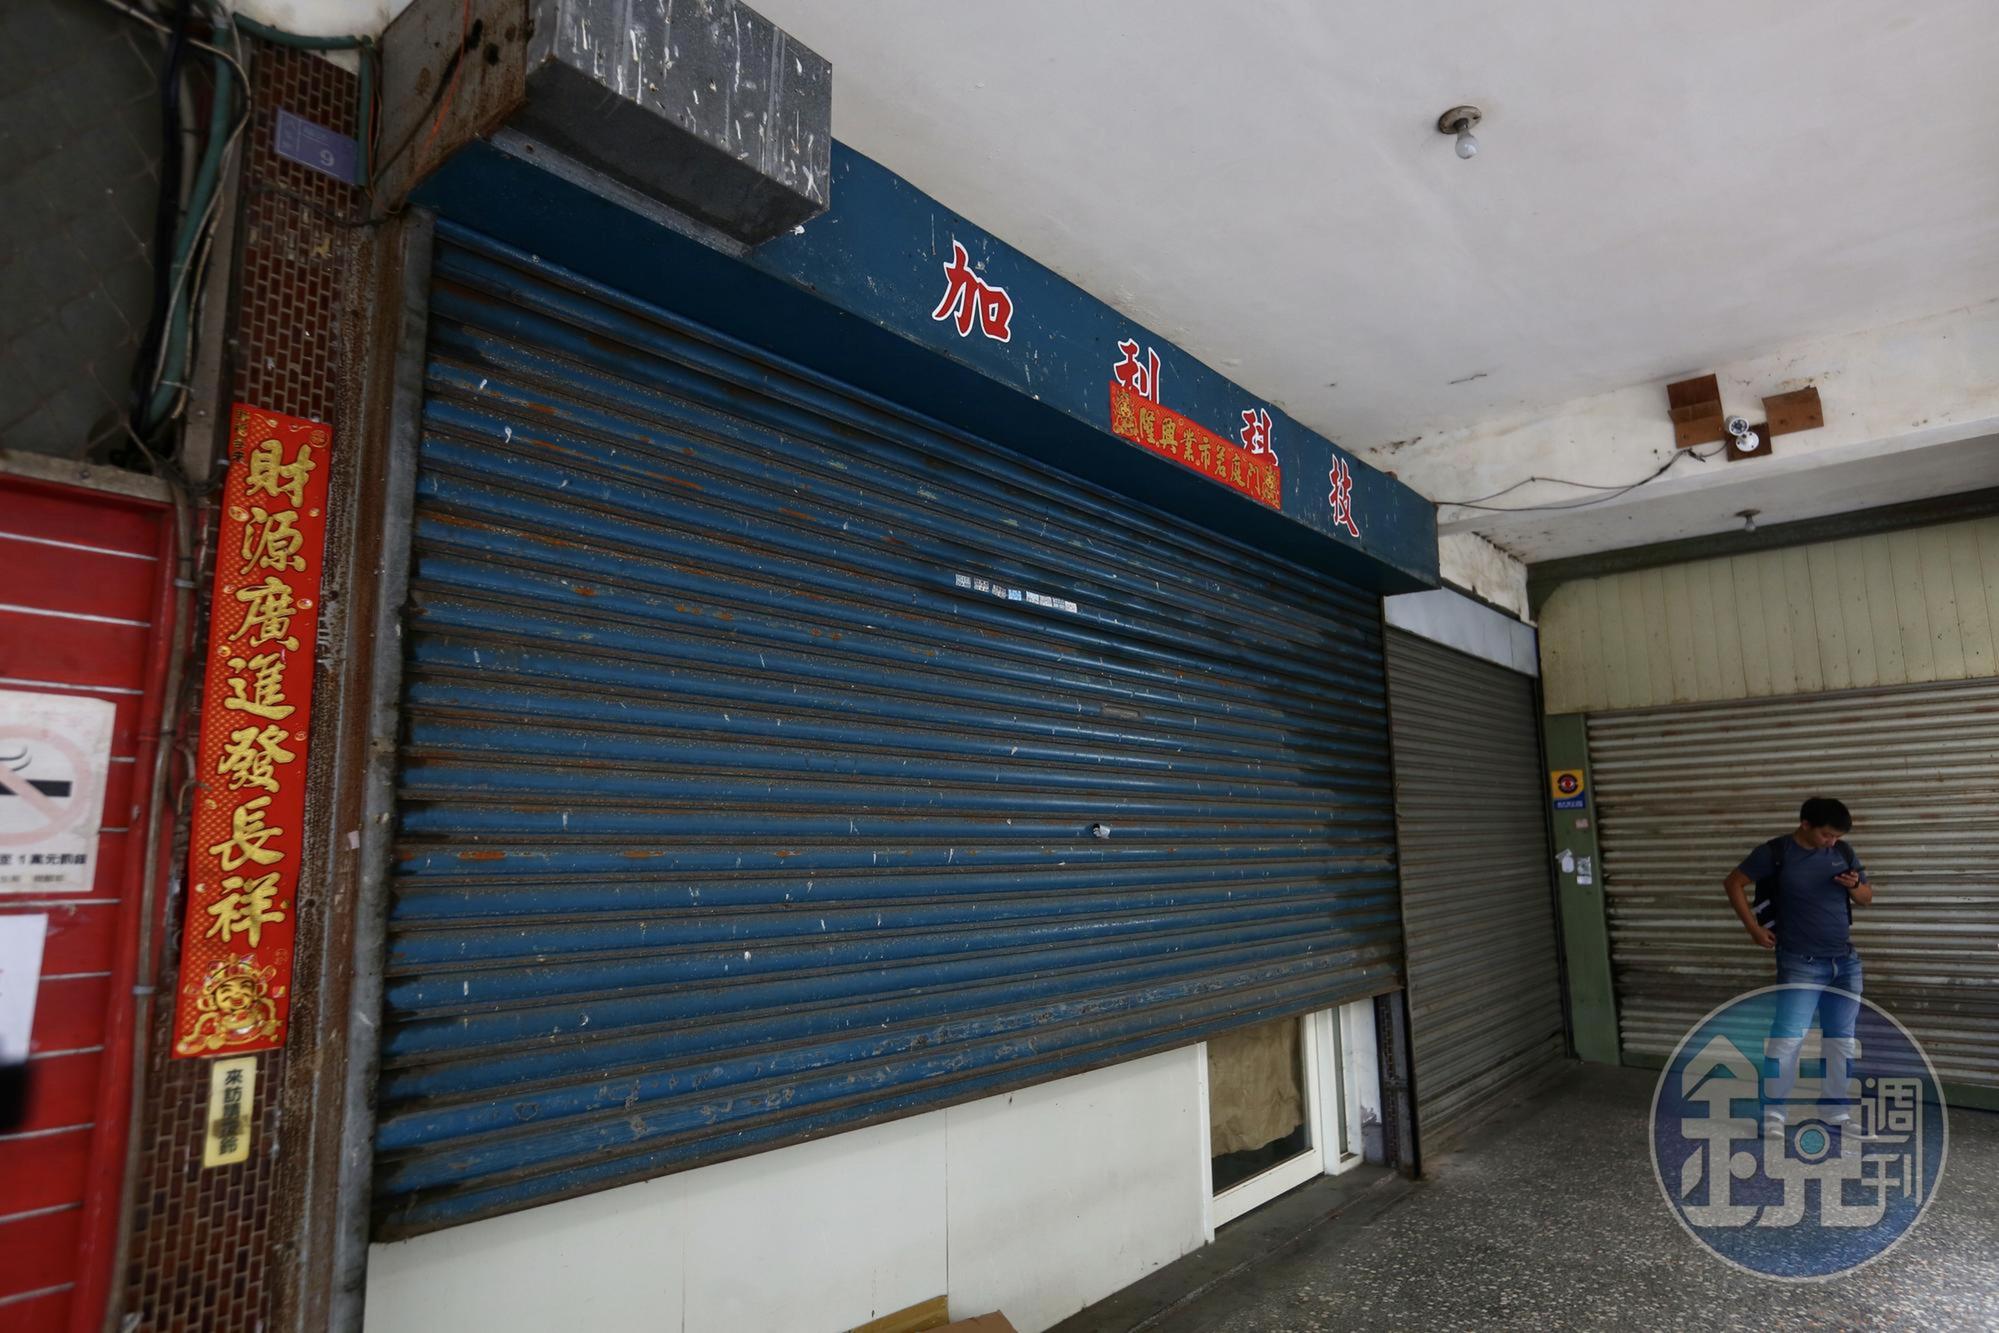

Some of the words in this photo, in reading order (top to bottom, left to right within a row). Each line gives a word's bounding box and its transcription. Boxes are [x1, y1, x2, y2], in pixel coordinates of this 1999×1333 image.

[320, 149, 335, 167] 9
[205, 438, 317, 950] 財源廣進發長祥
